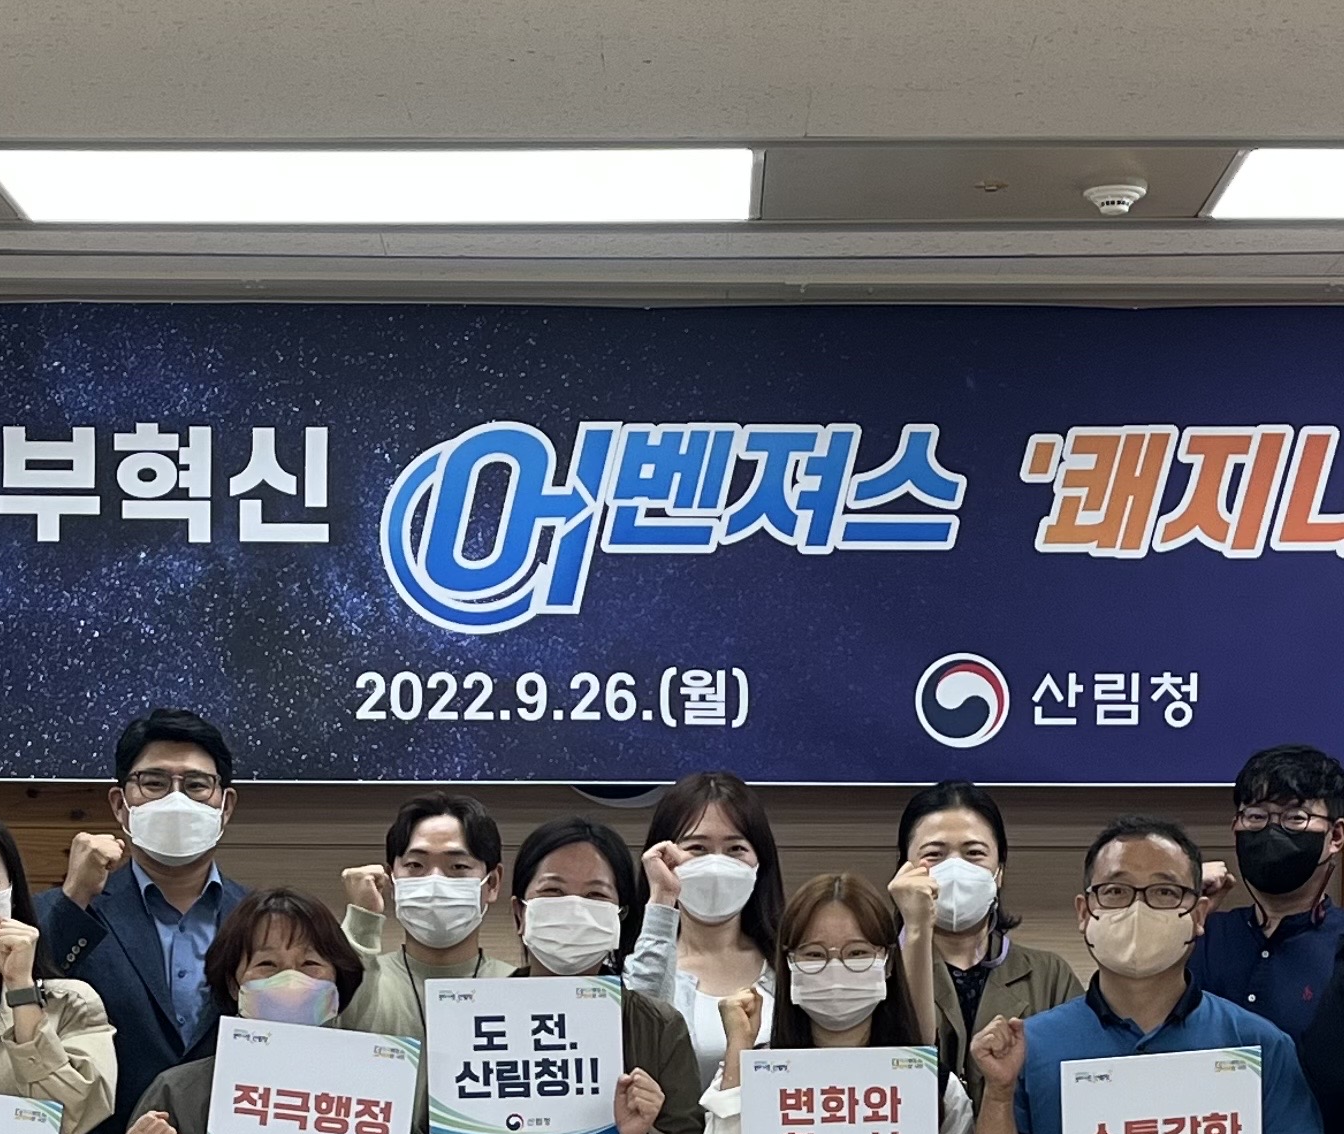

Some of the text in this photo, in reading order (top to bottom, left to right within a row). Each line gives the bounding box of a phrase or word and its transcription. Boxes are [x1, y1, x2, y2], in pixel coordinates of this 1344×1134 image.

[380, 420, 968, 634] 어벤져스
[354, 666, 750, 729] 2022.9.26.(월)
[1030, 667, 1202, 731] 산림청
[472, 1014, 509, 1052] 도
[454, 1057, 600, 1099] 산림청!!
[778, 1085, 902, 1127] 변화와
